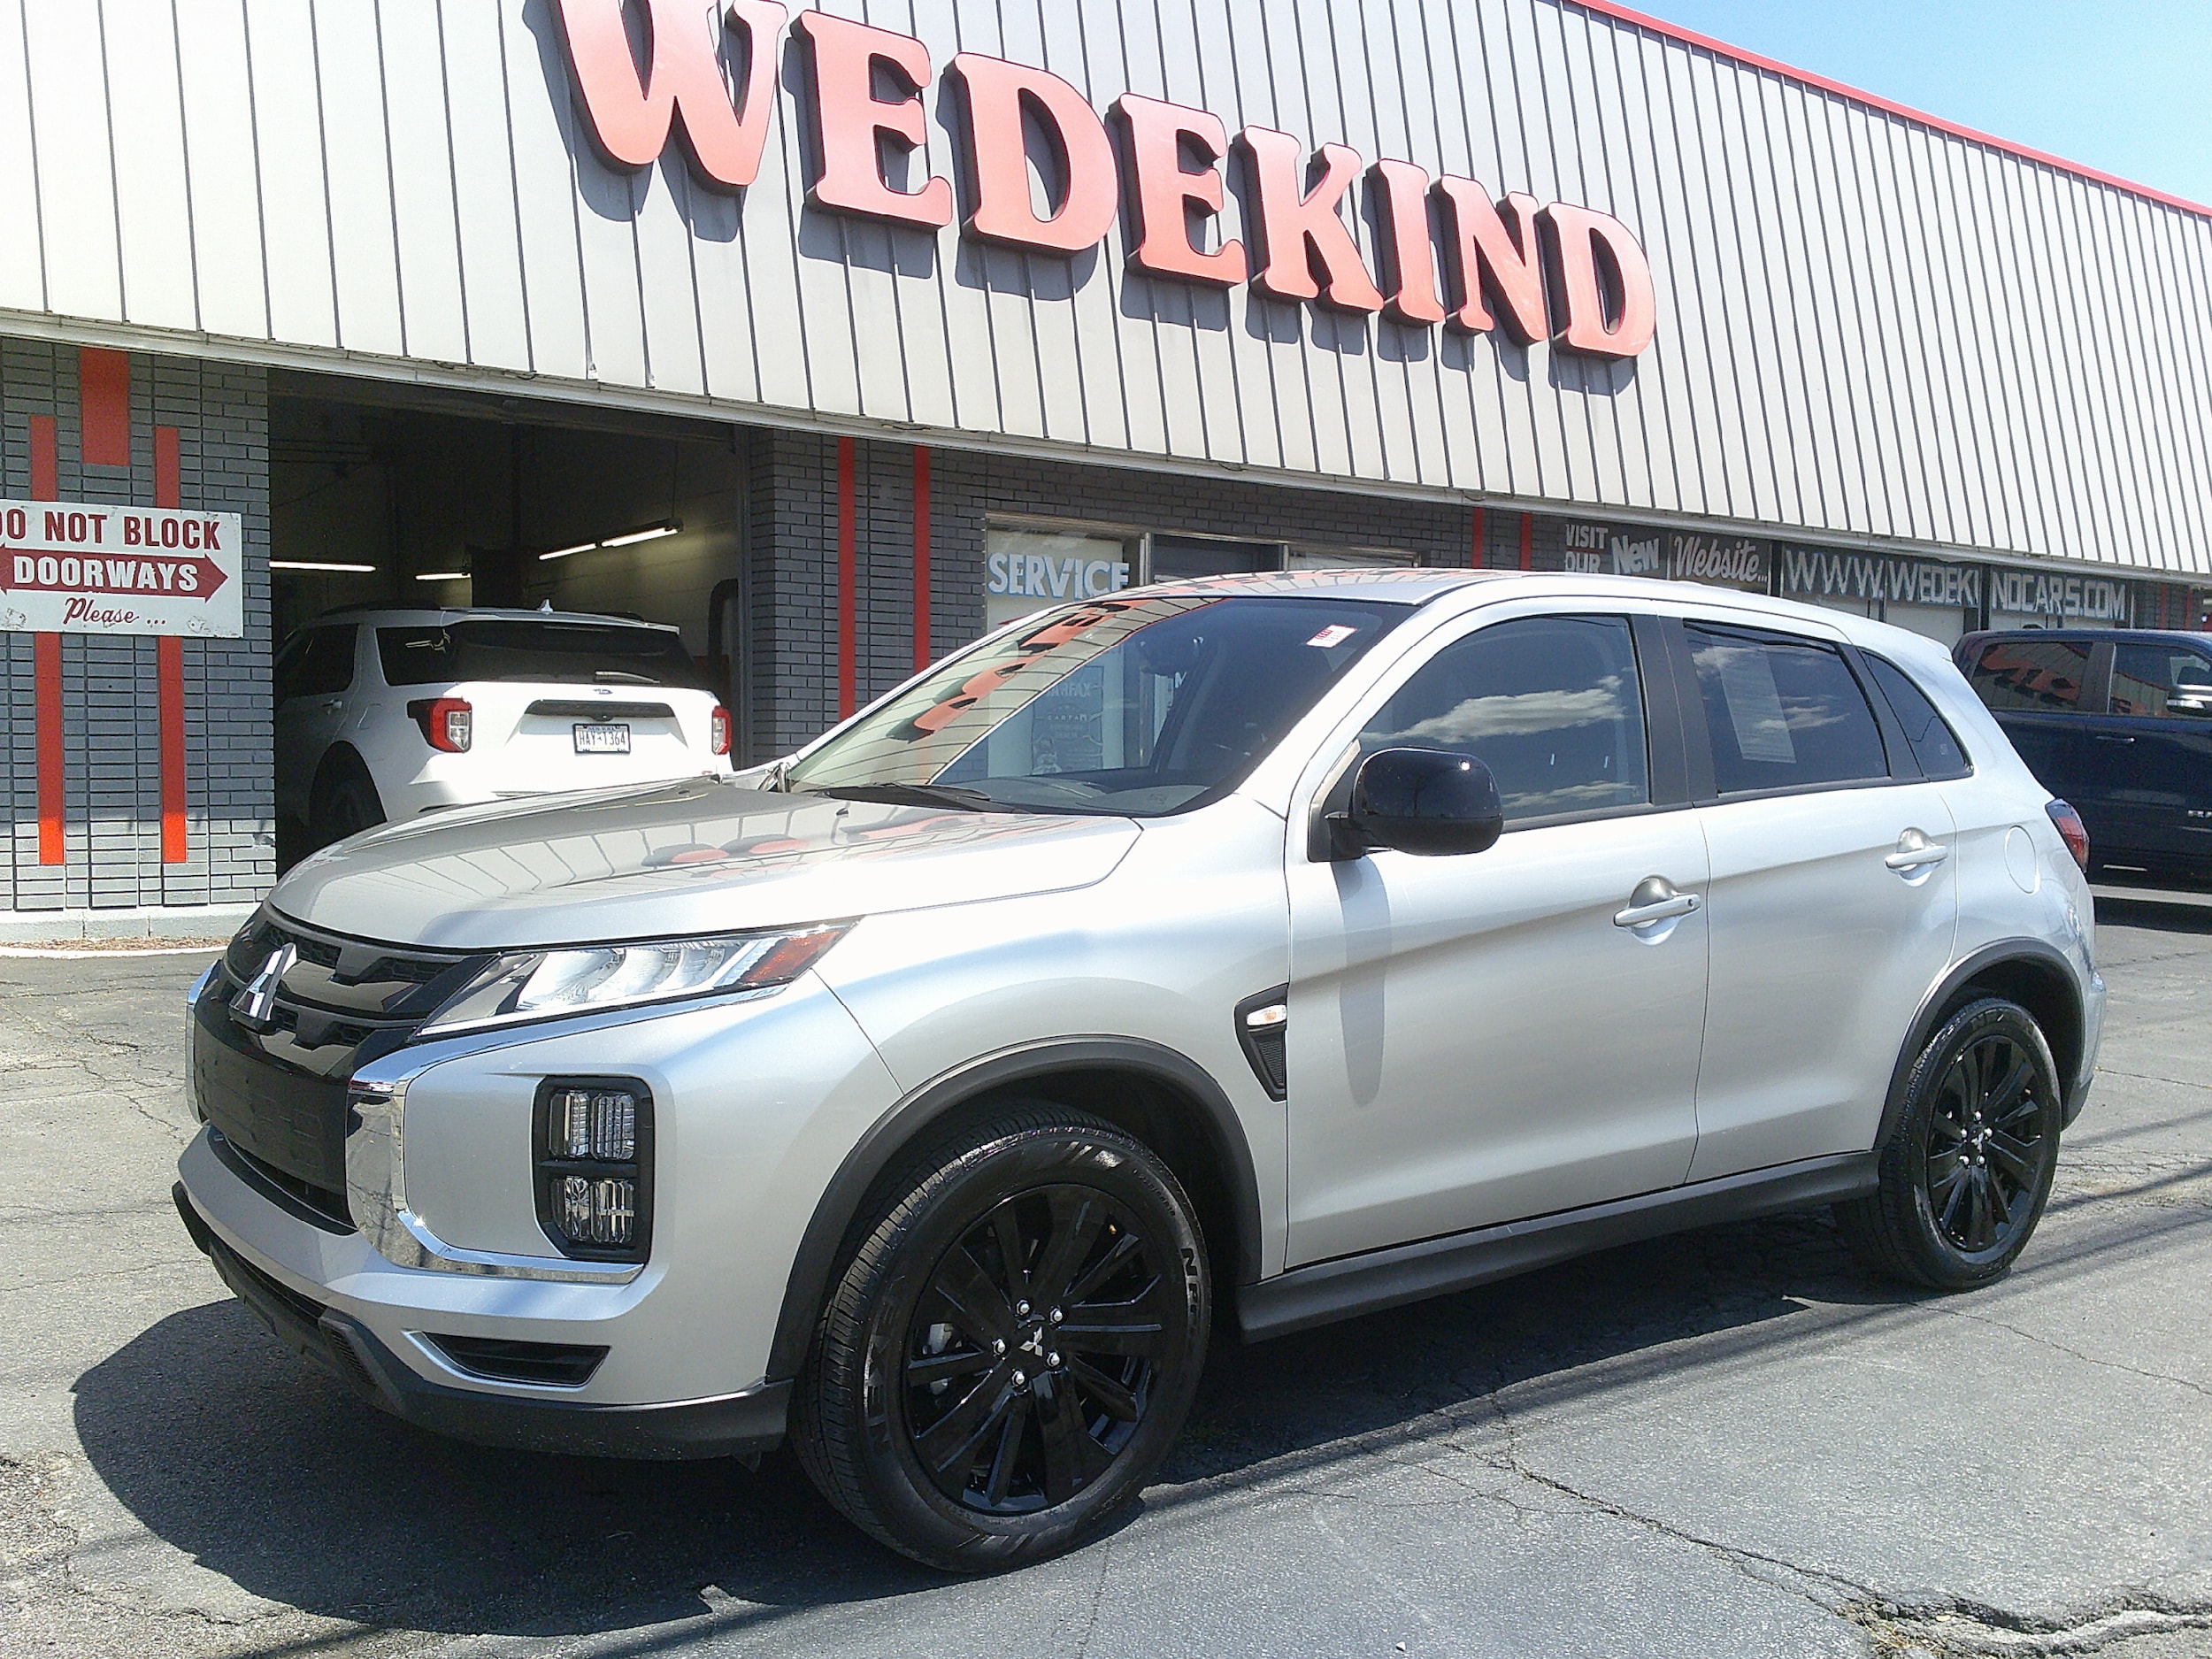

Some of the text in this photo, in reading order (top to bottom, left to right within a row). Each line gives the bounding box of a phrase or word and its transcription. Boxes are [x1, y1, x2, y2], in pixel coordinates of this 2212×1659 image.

[559, 0, 1656, 357] WEDEKIND
[0, 508, 221, 550] O NOT BLOCK
[1565, 524, 1609, 549] VISIT
[13, 556, 198, 592] DOORWAYS
[1564, 551, 1601, 573] OUR
[1611, 534, 1659, 575] New
[987, 552, 1129, 601] SERVICE
